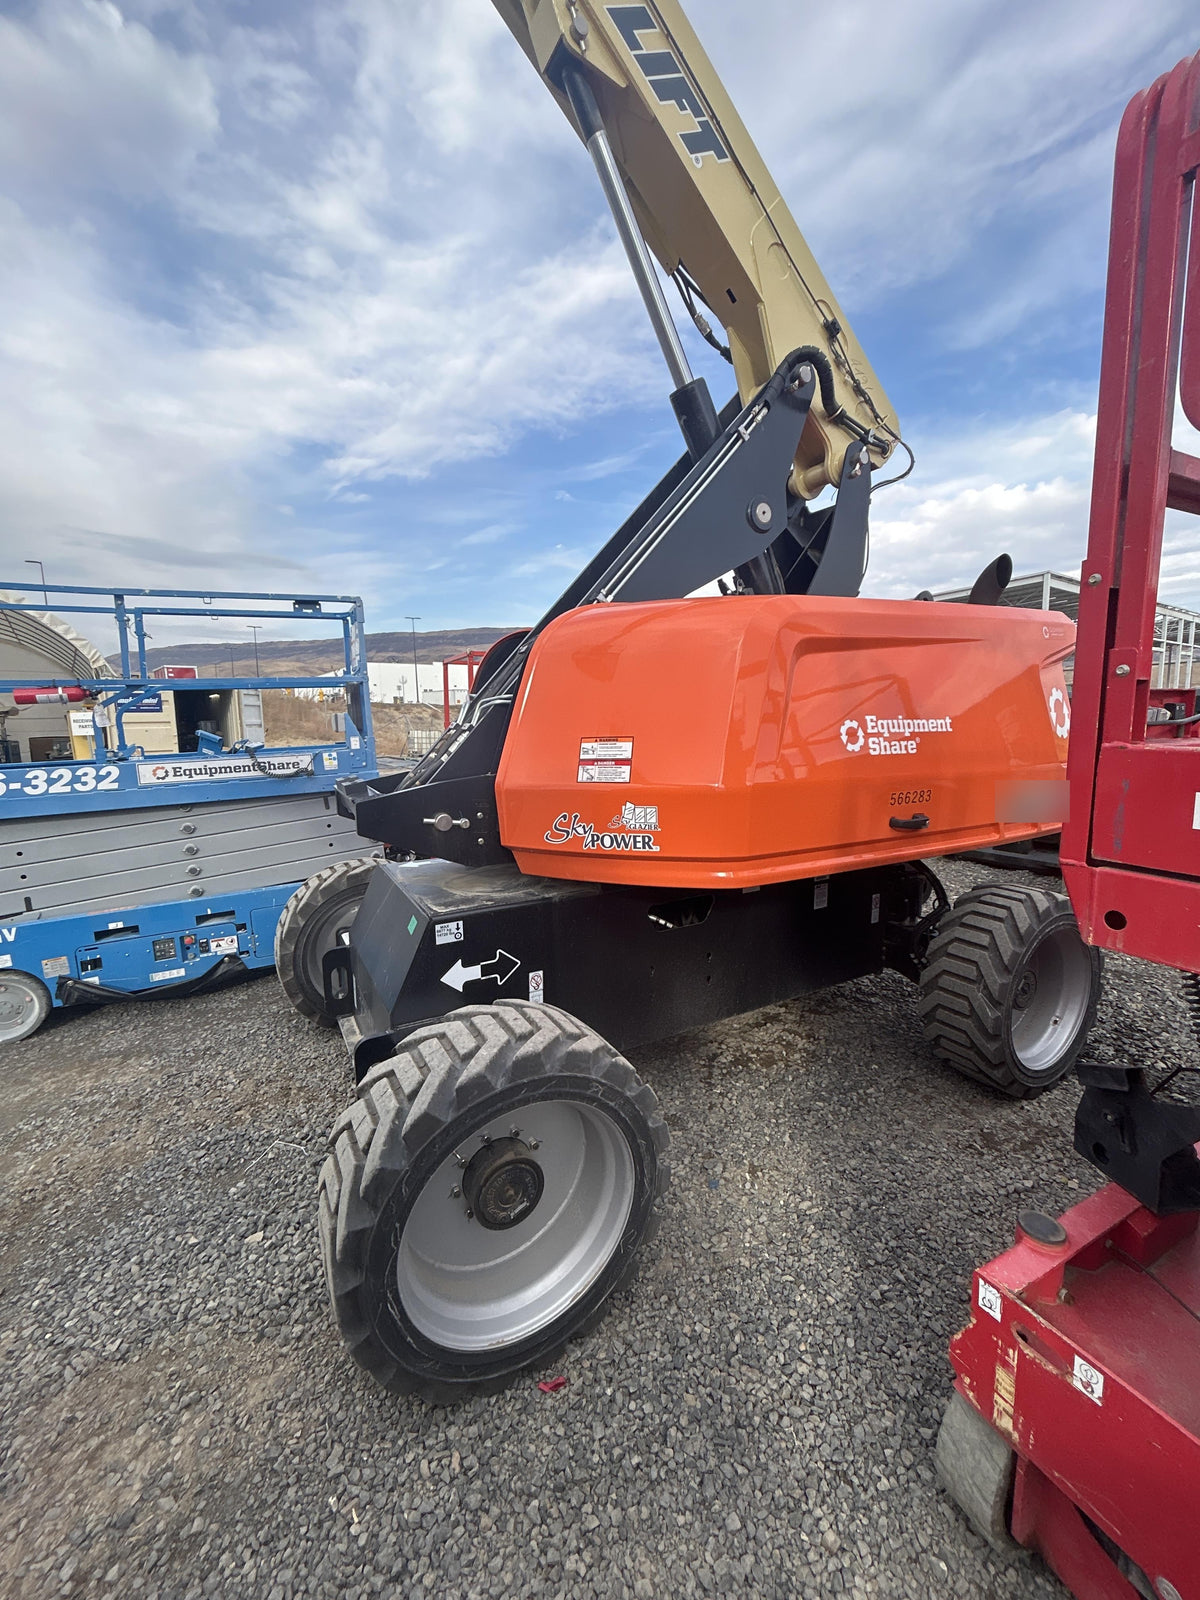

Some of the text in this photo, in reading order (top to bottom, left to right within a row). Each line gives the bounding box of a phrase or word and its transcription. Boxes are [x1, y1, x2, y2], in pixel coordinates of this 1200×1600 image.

[603, 4, 731, 164] LIFT
[865, 715, 953, 737] Equipment
[868, 737, 917, 756] Share
[890, 789, 932, 806] 566283
[544, 812, 655, 851] Sky POWER
